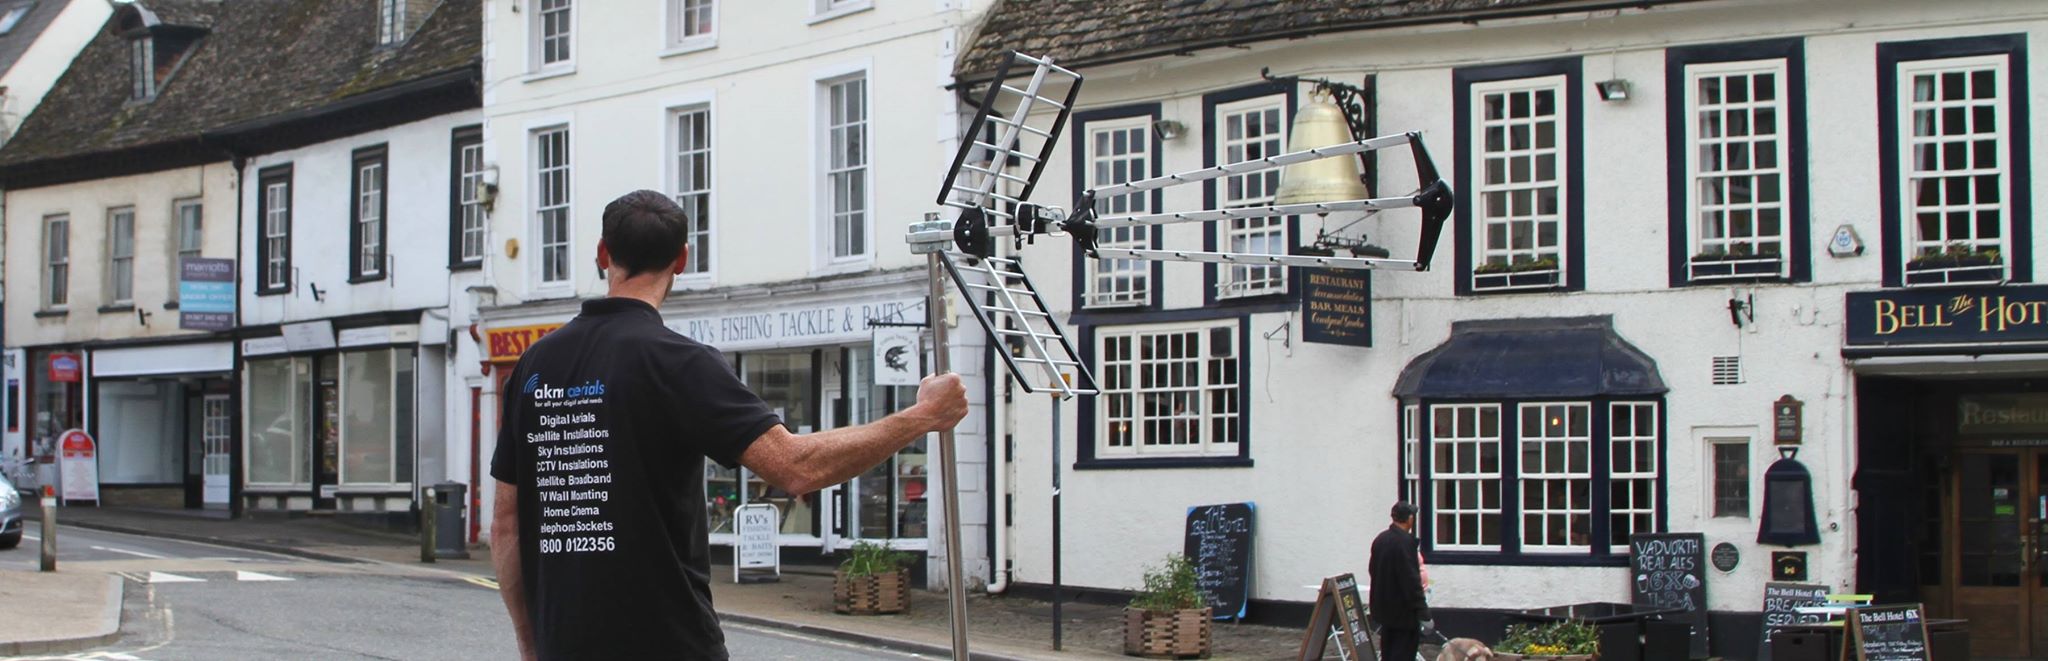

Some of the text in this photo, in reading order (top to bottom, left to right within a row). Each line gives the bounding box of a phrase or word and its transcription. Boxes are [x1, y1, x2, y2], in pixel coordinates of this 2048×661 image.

[1310, 274, 1365, 289] RESTAURANT
[1310, 301, 1365, 315] BAR MEALS
[1874, 293, 2048, 335] BELL The HOT
[721, 313, 773, 343] FISHING
[780, 308, 836, 338] TACKLE
[842, 307, 854, 333] &
[862, 302, 905, 332] BAITS
[489, 329, 532, 357] BEST
[534, 379, 605, 399] akm aerials
[540, 414, 571, 428] Digital
[538, 445, 553, 459] Sky
[549, 491, 569, 502] Wall
[543, 507, 570, 517] Home
[1204, 504, 1227, 521] THE
[576, 521, 614, 532] Sockets
[746, 515, 768, 525] RV's
[1190, 517, 1248, 536] BELL HOTEL
[566, 536, 615, 553] 0122356
[1637, 555, 1695, 571] REAL ALES
[1649, 571, 1684, 591] 6X
[1767, 587, 1780, 596] The
[1781, 588, 1794, 596] Bell
[1795, 589, 1813, 597] Hotel
[1860, 609, 1919, 623] The Bell Hotel 6X
